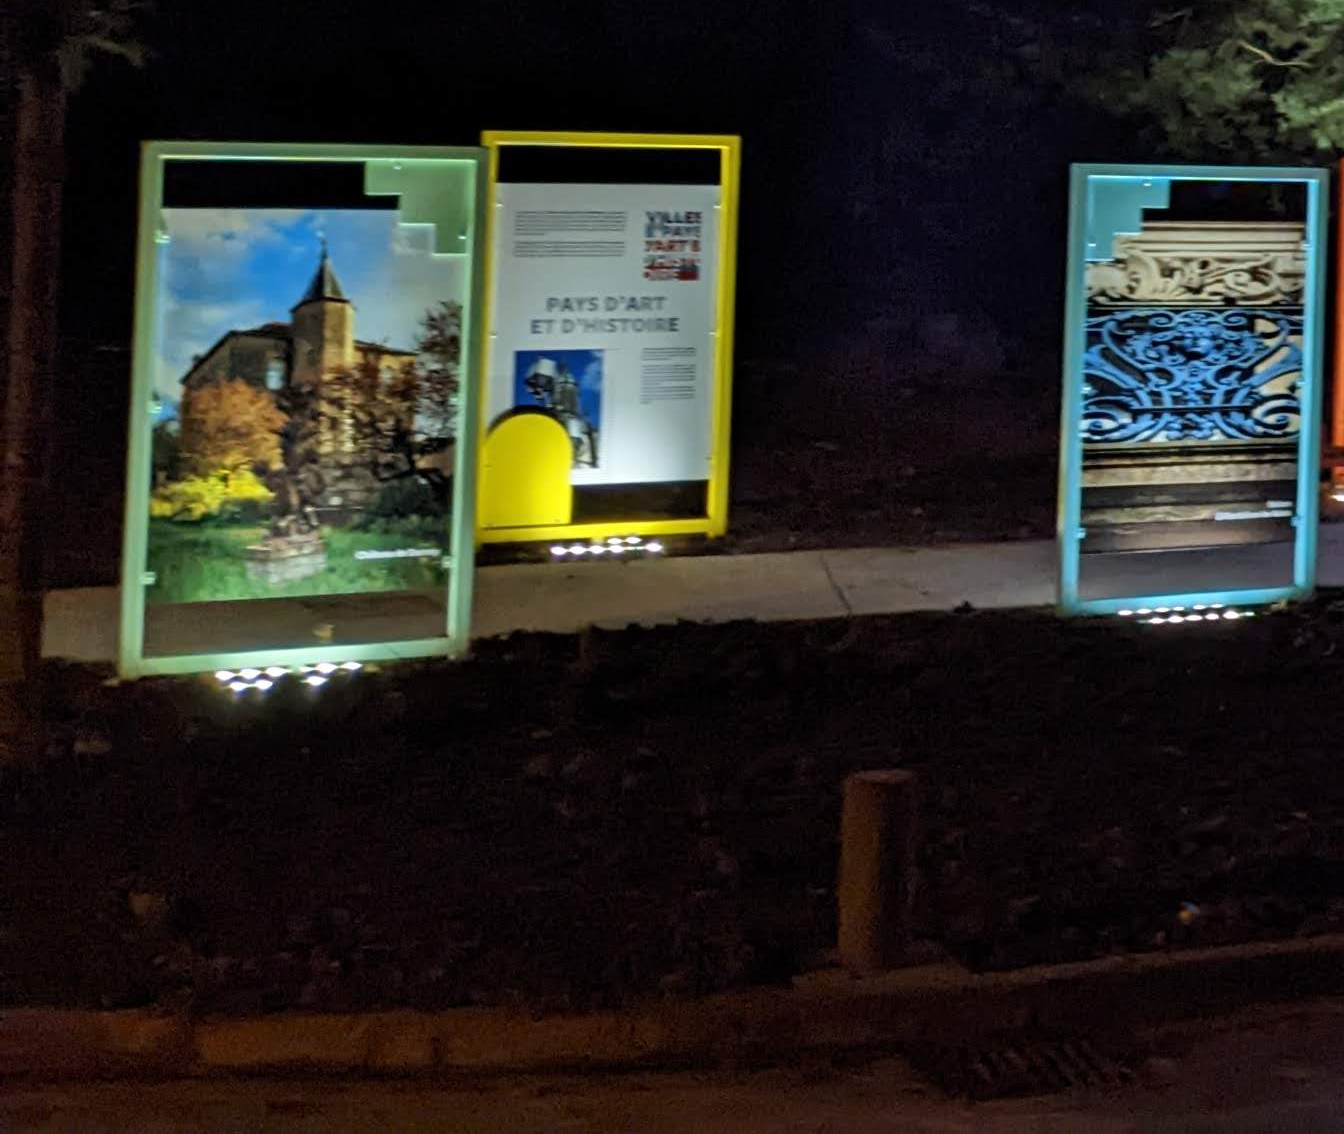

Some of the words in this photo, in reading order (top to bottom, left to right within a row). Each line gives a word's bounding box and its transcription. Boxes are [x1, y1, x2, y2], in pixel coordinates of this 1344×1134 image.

[546, 296, 599, 312] PAYS
[604, 295, 668, 312] D'ART
[530, 318, 556, 334] ET
[561, 317, 680, 334] D'HISTOIRE
